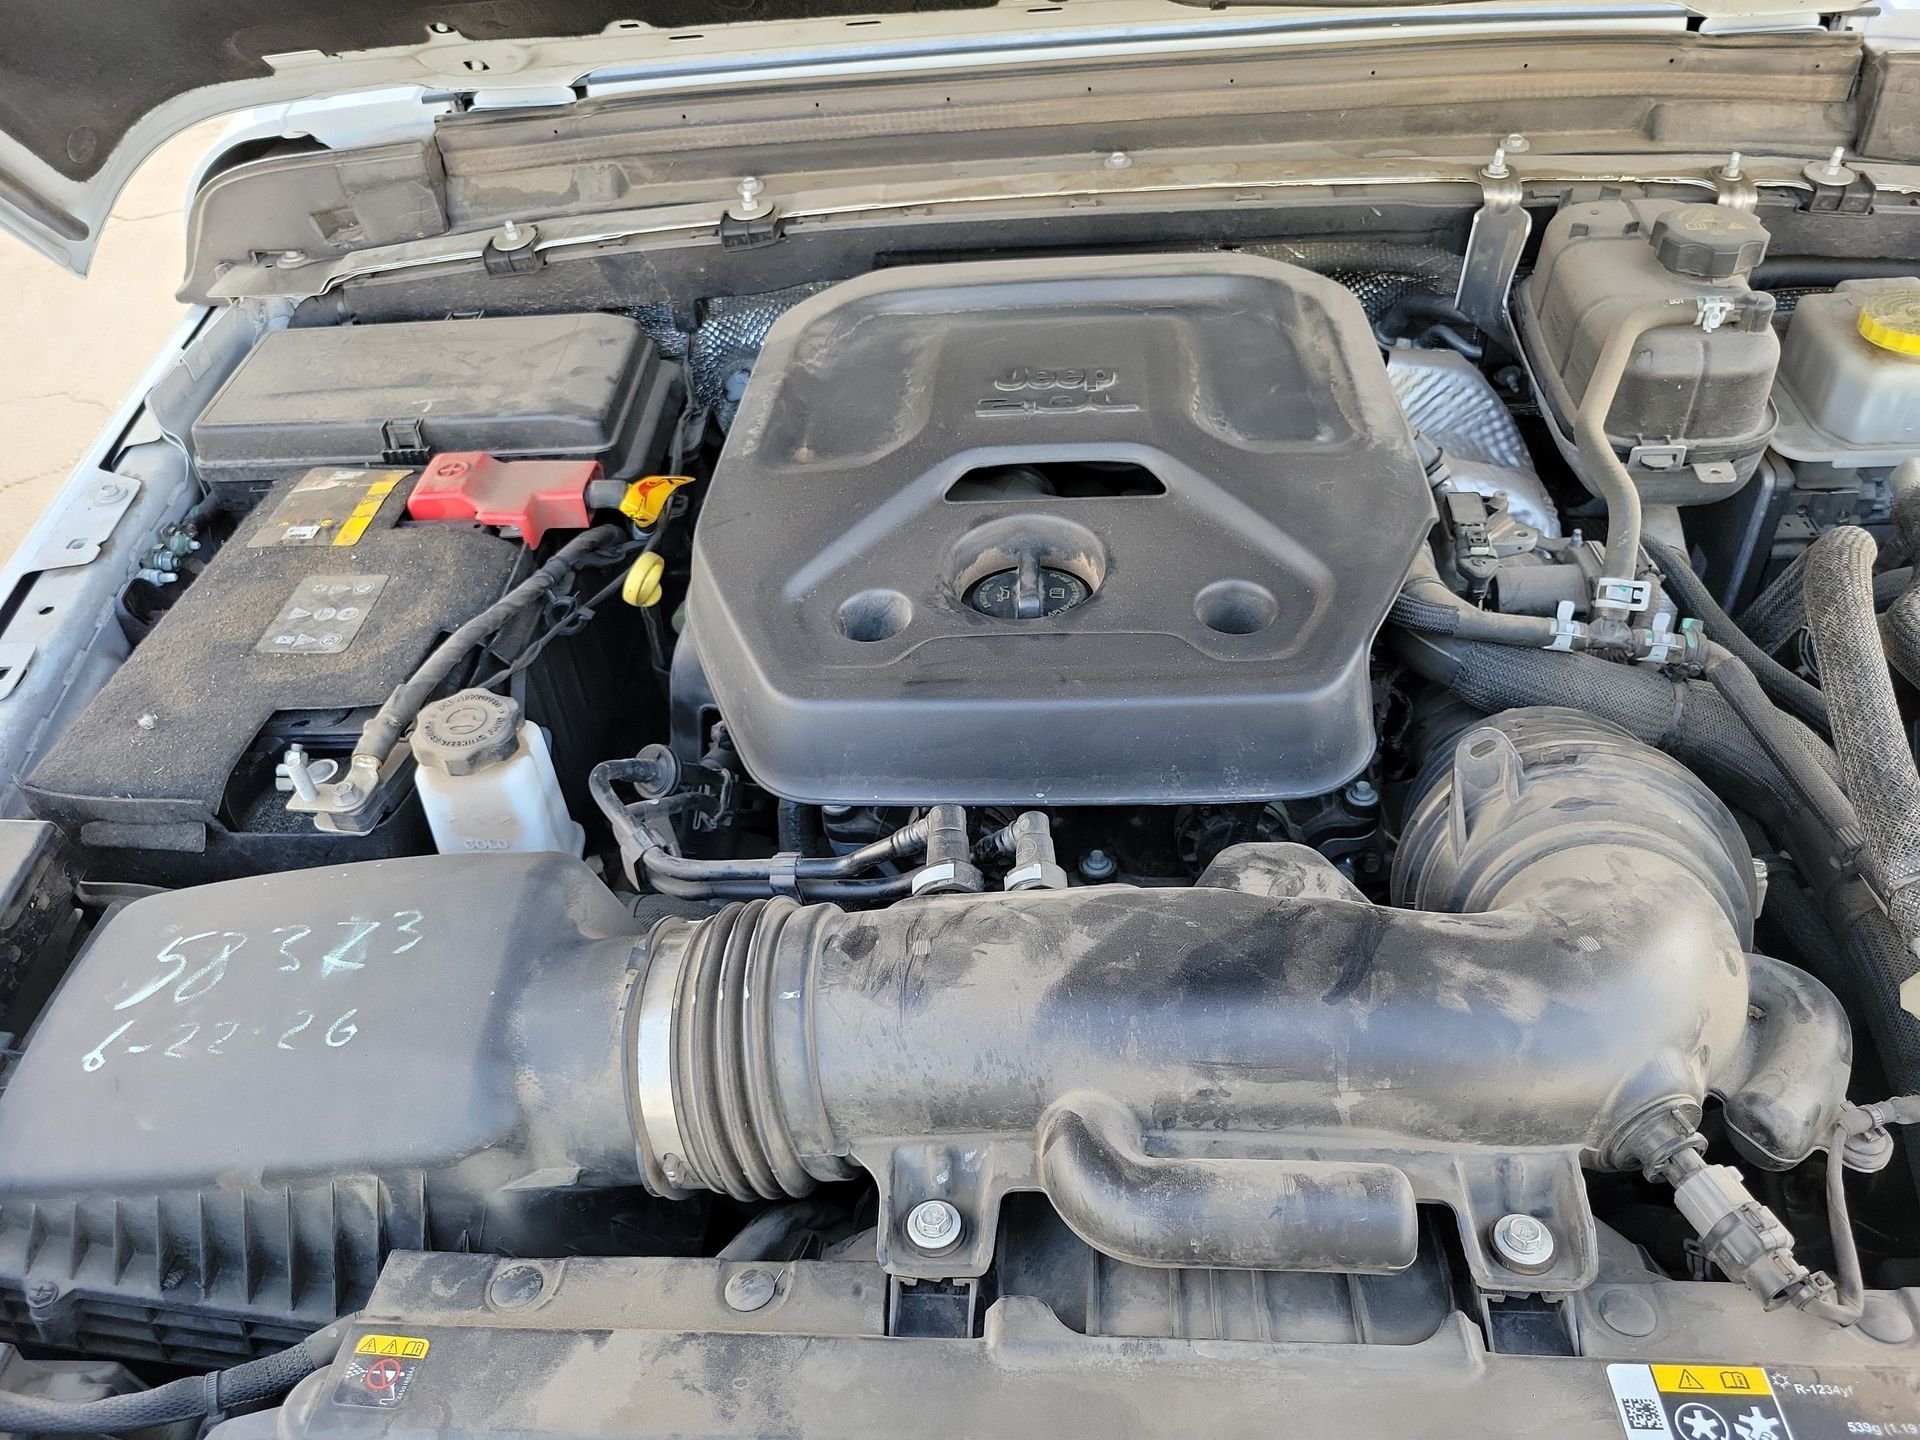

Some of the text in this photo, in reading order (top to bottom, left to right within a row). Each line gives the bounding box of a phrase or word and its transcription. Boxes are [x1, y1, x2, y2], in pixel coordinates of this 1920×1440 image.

[993, 365, 1117, 391] Jeep
[464, 840, 509, 849] COLD
[1794, 1383, 1853, 1397] R-1234yf
[1847, 1421, 1882, 1436] 539g
